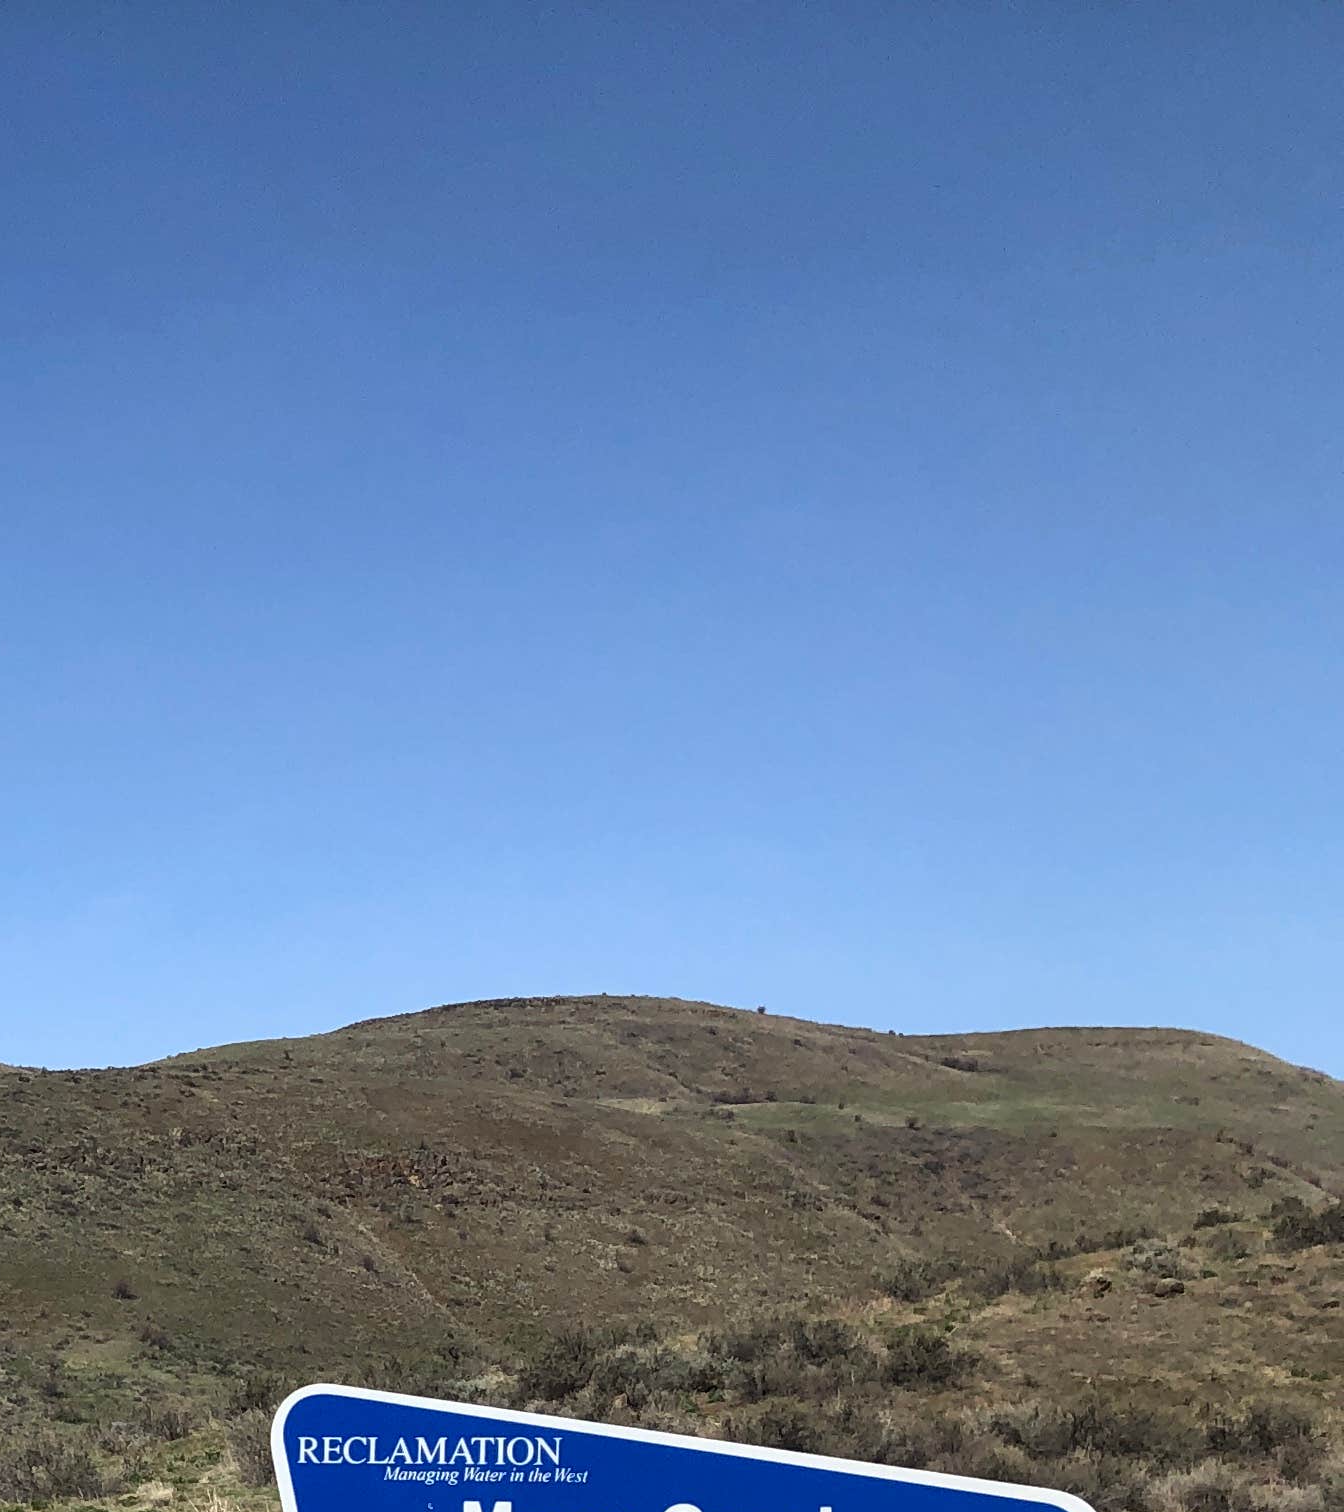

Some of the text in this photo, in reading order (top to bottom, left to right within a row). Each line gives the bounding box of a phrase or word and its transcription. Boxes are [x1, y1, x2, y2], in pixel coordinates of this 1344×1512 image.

[297, 1436, 563, 1466] RECLAMATION
[384, 1466, 588, 1486] Managing Water in the West
